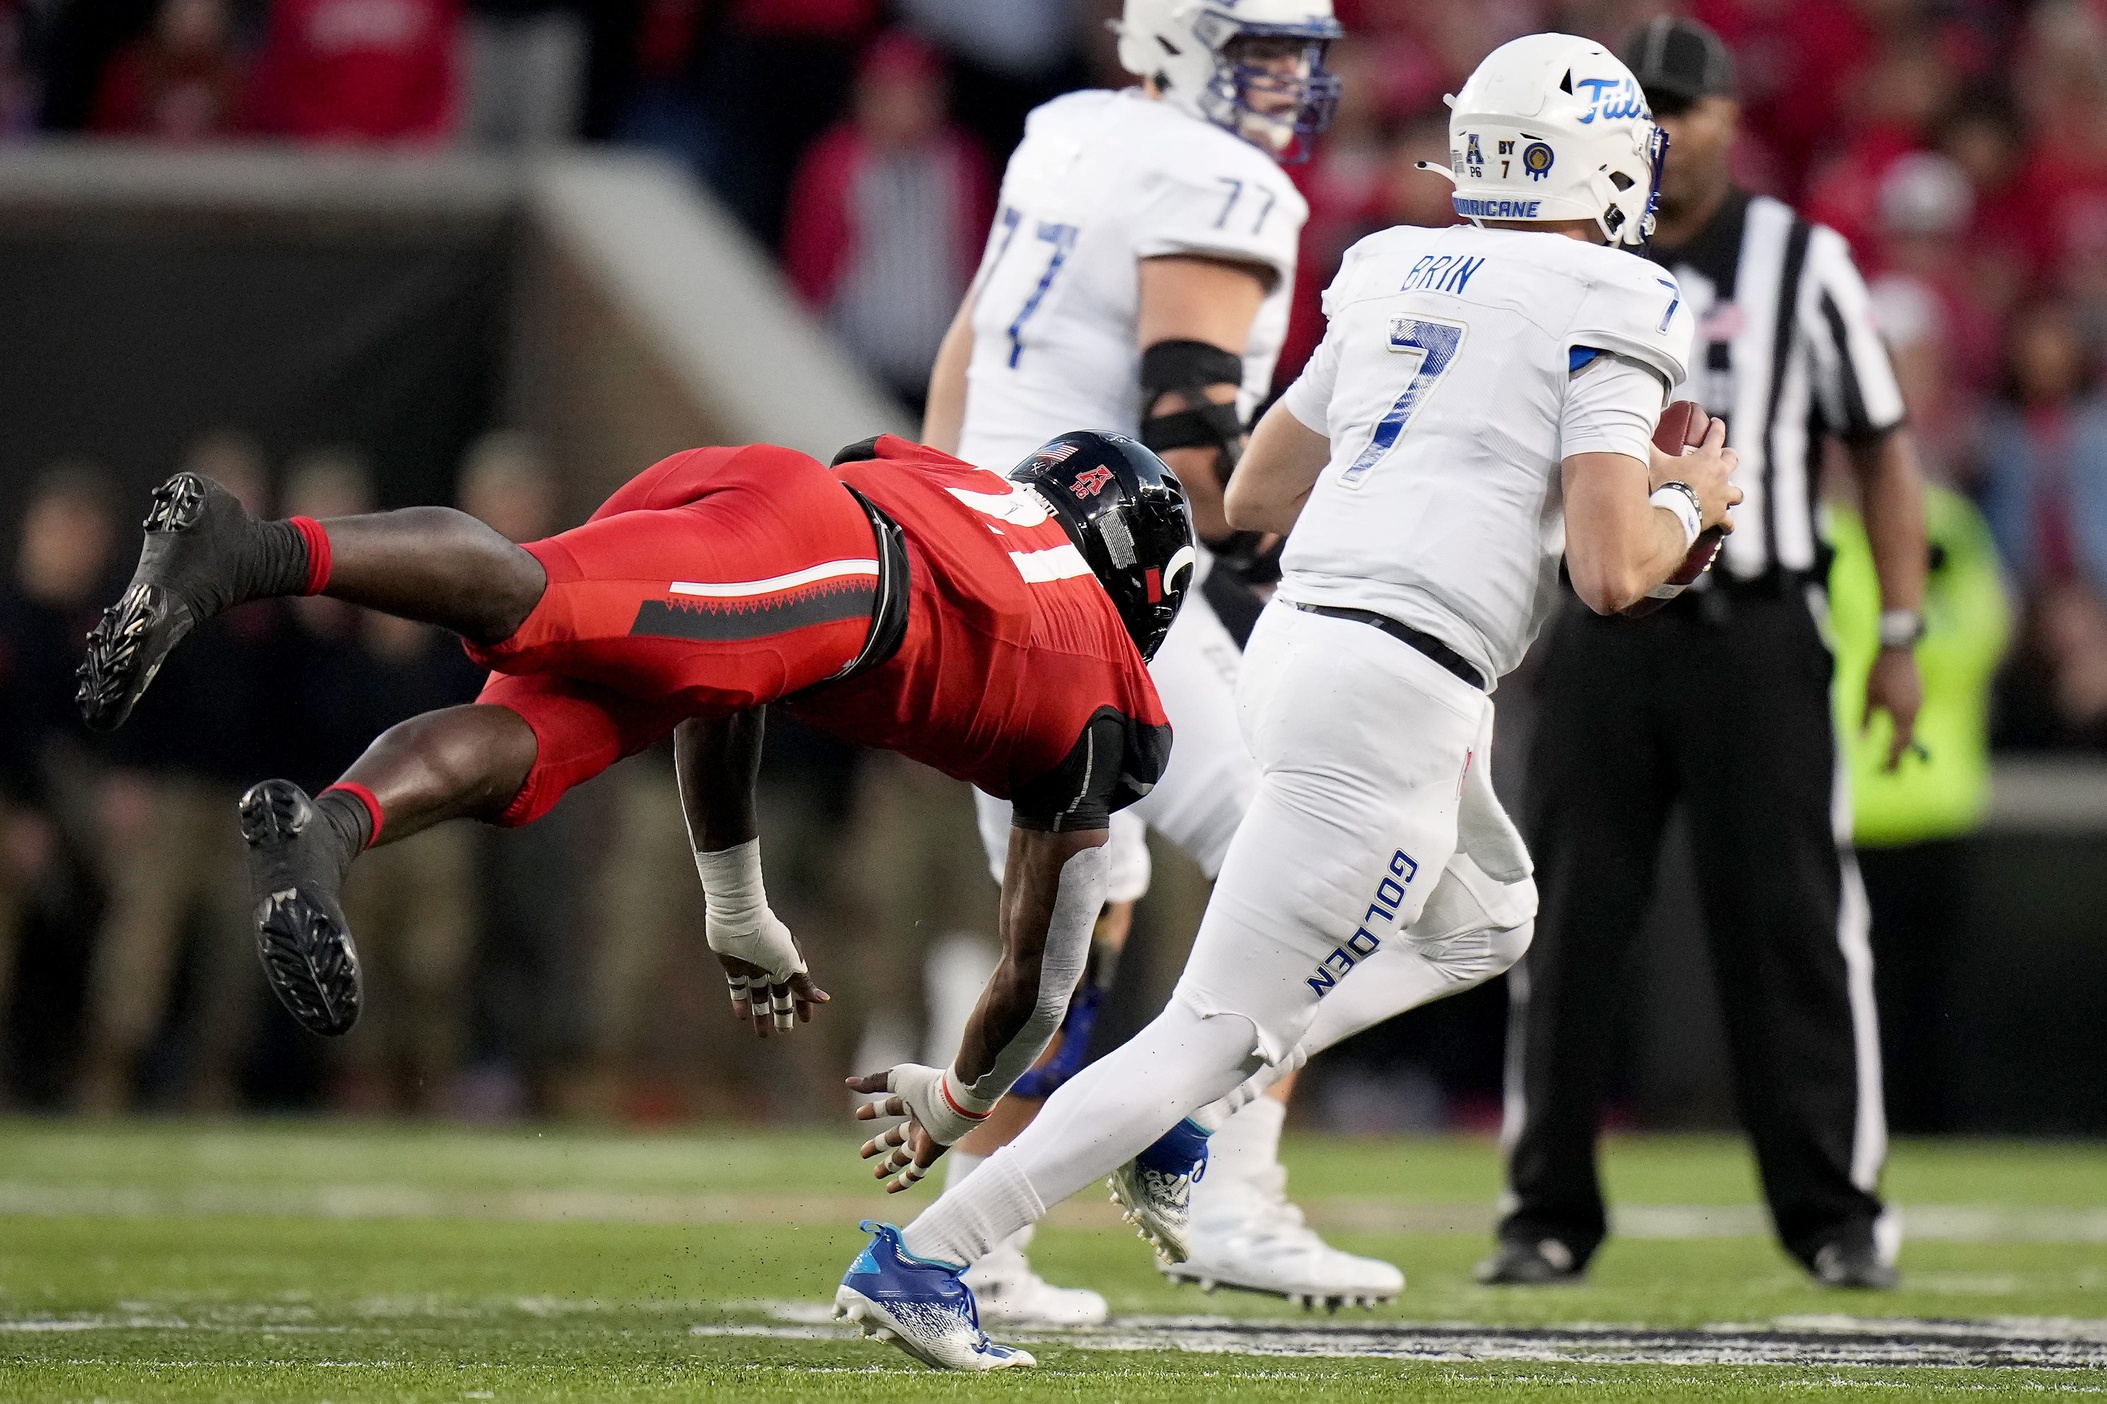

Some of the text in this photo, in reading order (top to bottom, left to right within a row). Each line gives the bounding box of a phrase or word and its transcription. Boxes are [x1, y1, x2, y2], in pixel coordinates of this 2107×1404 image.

[1499, 141, 1515, 155] BY
[1470, 166, 1482, 178] P6
[1501, 161, 1510, 178] 7
[1215, 176, 1276, 236] 77
[1400, 255, 1486, 295] BRIN
[1655, 277, 1682, 335] 7
[1337, 313, 1469, 491] 7
[1069, 481, 1090, 500] P6
[1304, 847, 1419, 1000] GOLDEN
